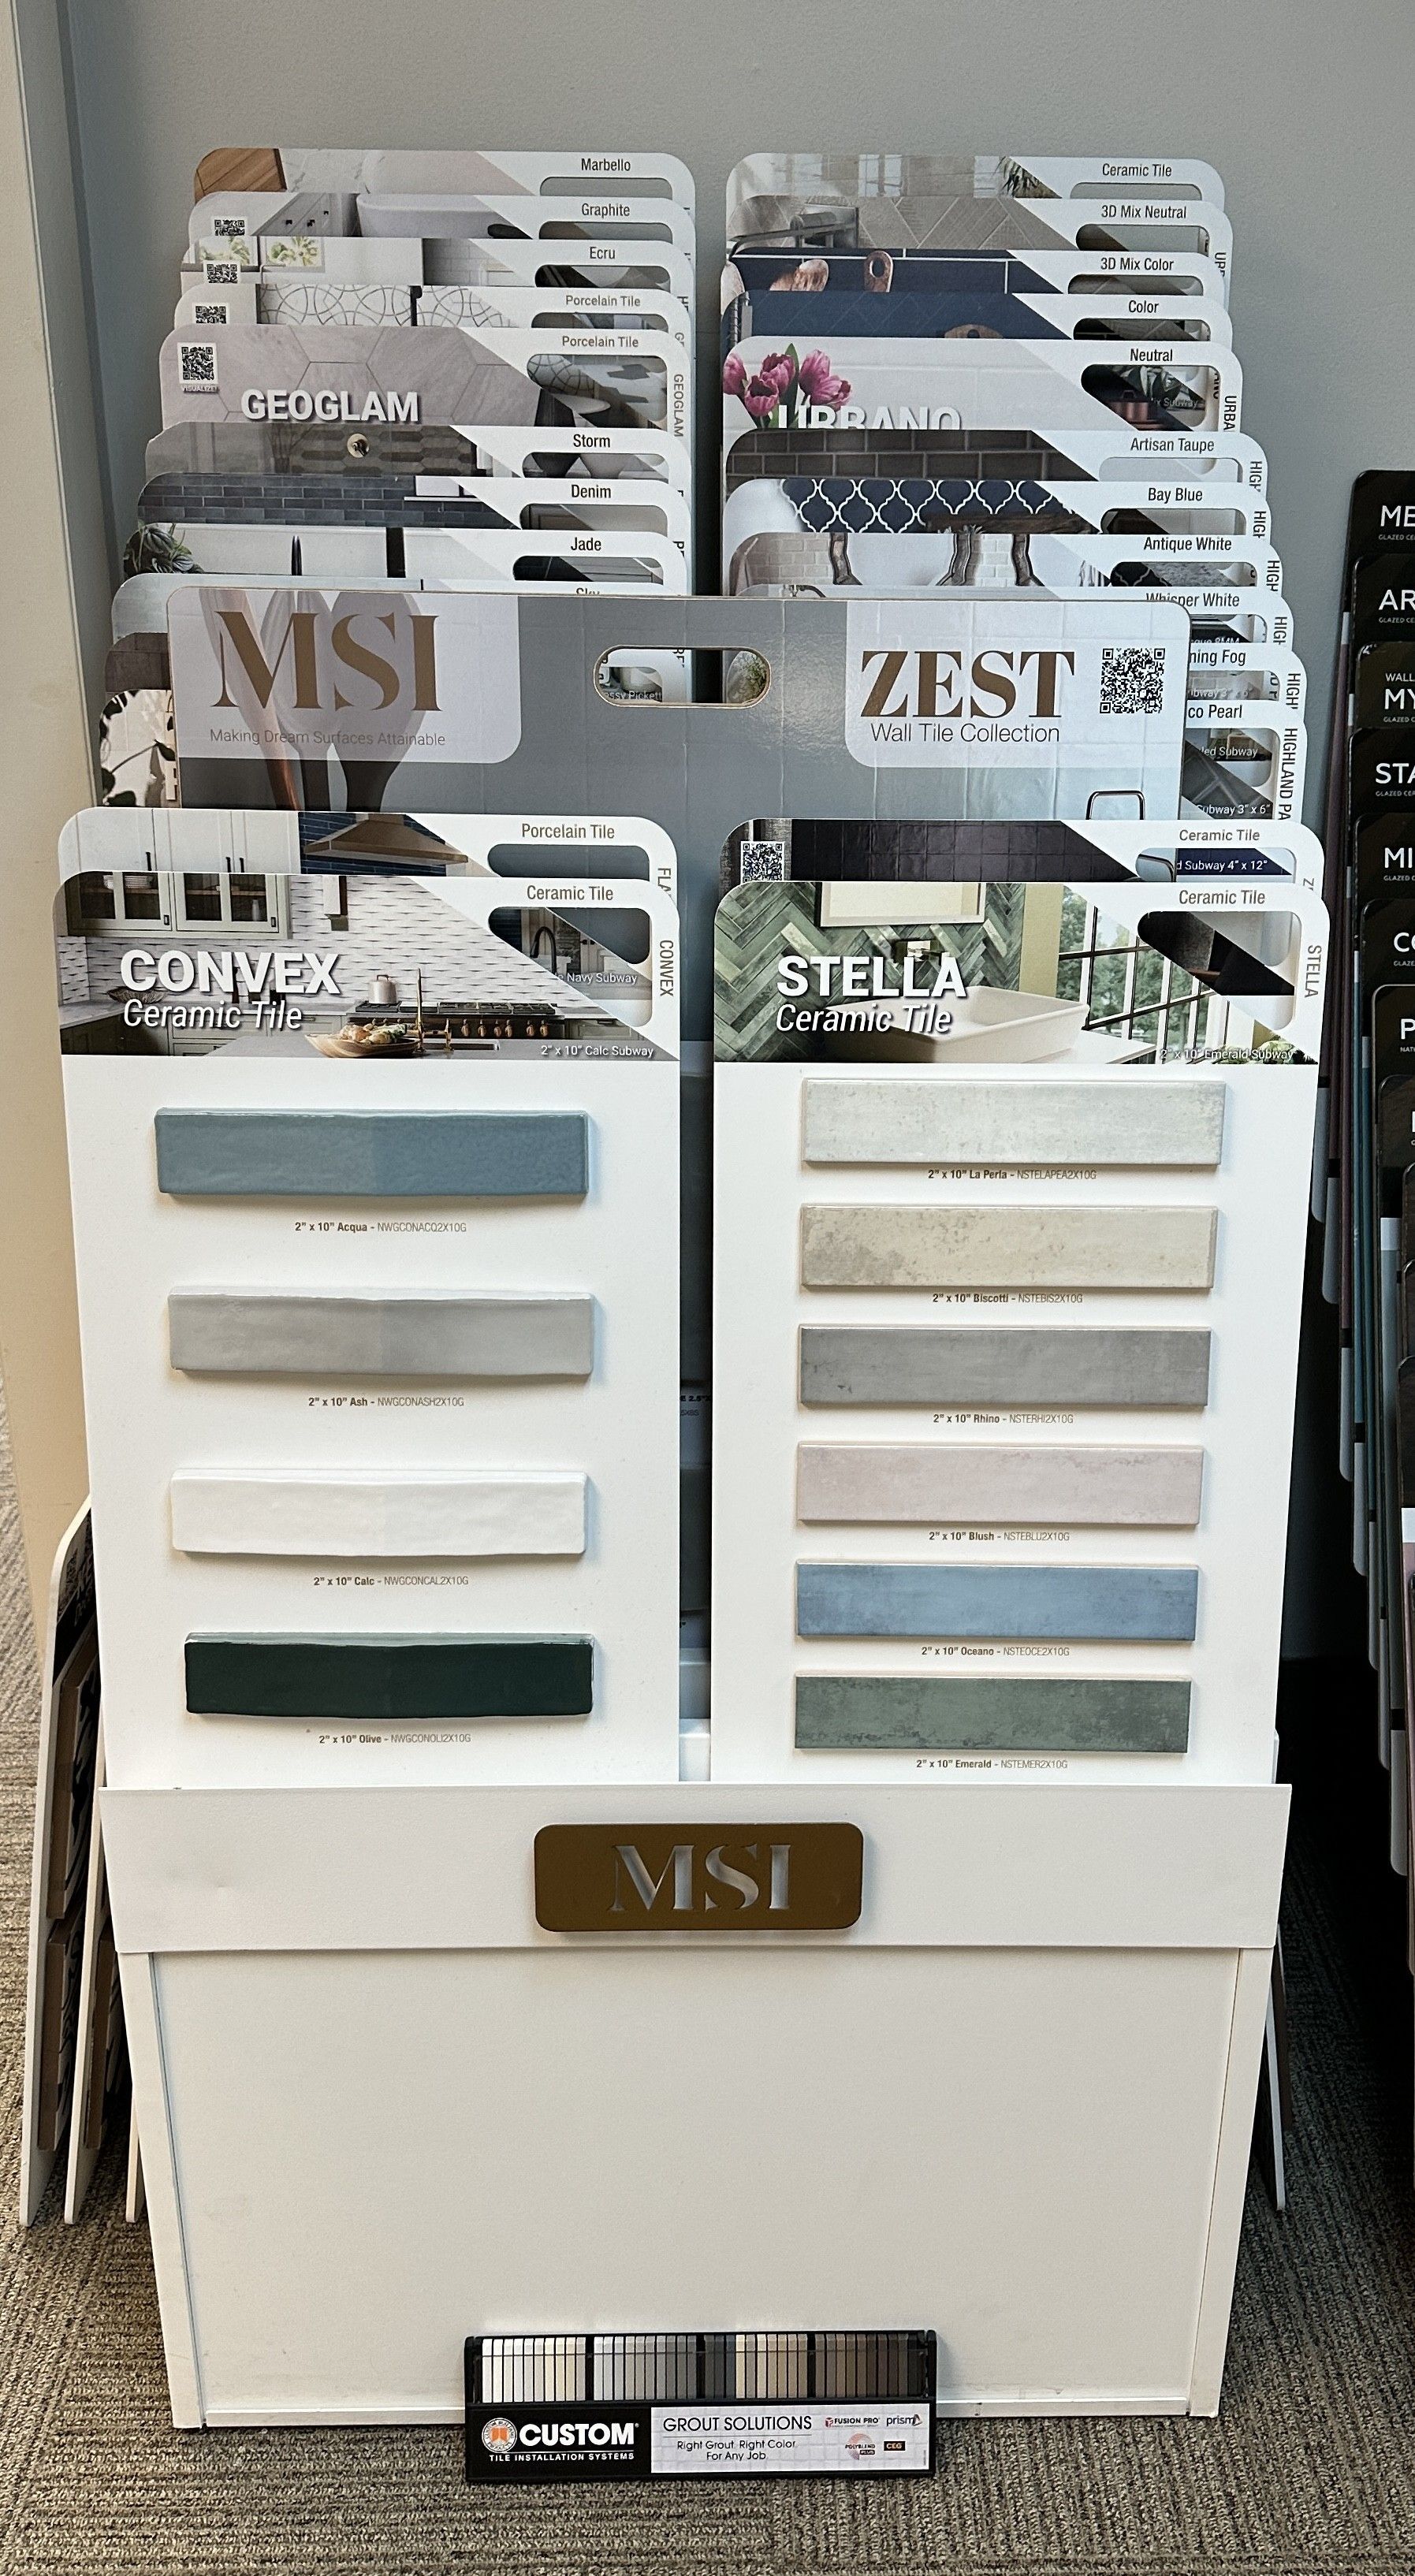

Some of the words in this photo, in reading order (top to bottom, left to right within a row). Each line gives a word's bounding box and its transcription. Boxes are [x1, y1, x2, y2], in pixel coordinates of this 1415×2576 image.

[581, 158, 631, 171] Marbello
[1103, 163, 1149, 177] Ceramic
[1152, 164, 1172, 177] Tile
[582, 203, 630, 218] Graphite
[1101, 205, 1117, 218] 3D
[1121, 206, 1141, 218] Mix
[1145, 206, 1187, 219] Neutral
[590, 247, 616, 259] Ecru
[1101, 258, 1115, 270] 3D
[1120, 258, 1140, 270] Mix
[1144, 258, 1174, 271] Color
[566, 295, 617, 307] Porcelain
[620, 296, 640, 307] Tile
[1128, 300, 1159, 313] Color
[562, 336, 614, 348] Porcelain
[618, 337, 639, 348] Tile
[1130, 348, 1173, 362] Neutral
[241, 389, 419, 422] GEOGLAM
[674, 374, 683, 437] GEOGLAM
[573, 434, 610, 448] Storm
[1130, 437, 1174, 452] Artisan
[1178, 438, 1214, 454] Taupe
[572, 484, 611, 498] Denim
[1148, 487, 1171, 504] Bay
[1175, 488, 1203, 501] Blue
[571, 537, 601, 551] Jade
[1144, 538, 1193, 553] Antique
[1196, 538, 1231, 551] White
[1203, 593, 1240, 607] White
[210, 610, 443, 712] MSI
[1222, 650, 1246, 666] Fog
[861, 650, 1075, 719] ZEST
[1208, 705, 1243, 719] Pearl
[210, 728, 260, 746] Making
[265, 730, 310, 744] Dream
[314, 731, 374, 745] Surfaces
[378, 731, 446, 746] Attainable
[870, 723, 912, 742] Wall
[921, 723, 953, 742] Tile
[961, 723, 1059, 743] Collection
[1219, 747, 1258, 759] Subway
[1279, 728, 1298, 799] HIGHLAND
[522, 824, 586, 838] Porcelain
[590, 825, 615, 839] Tile
[1179, 829, 1233, 842] Ceramic
[1236, 829, 1260, 842] Tile
[1185, 861, 1225, 873] Subway
[527, 885, 585, 900] Ceramic
[588, 886, 613, 900] Tile
[1179, 890, 1236, 904] Ceramic
[1241, 889, 1265, 904] Tile
[121, 949, 341, 994] CONVEX
[660, 940, 674, 997] CONVEX
[776, 953, 966, 998] STELLA
[1305, 945, 1321, 998] STELLA
[567, 973, 593, 985] Navy
[596, 973, 638, 985] Subway
[124, 999, 241, 1029] Ceramic
[251, 1000, 303, 1029] Tile
[776, 1003, 892, 1032] Ceramic
[903, 1003, 952, 1033] Tile
[585, 1045, 609, 1056] Calc
[612, 1045, 654, 1058] Subway
[1205, 1049, 1249, 1059] Emerald
[1252, 1049, 1293, 1062] Subway
[970, 1170, 981, 1179] La
[984, 1170, 1007, 1179] Perla
[337, 1223, 367, 1233] Acqua
[974, 1294, 1008, 1302] Biscotti
[350, 1398, 367, 1406] Ash
[974, 1414, 1000, 1423] Rhino
[355, 1576, 374, 1585] Calc
[359, 1735, 382, 1744] Olive
[955, 1759, 992, 1768] Emerald
[608, 1844, 791, 1912] MSI
[663, 2417, 720, 2432] GROUT
[724, 2416, 812, 2430] SOLUTIONS
[677, 2440, 702, 2451] Right
[739, 2440, 765, 2451] Right
[706, 2451, 722, 2461] For
[724, 2451, 744, 2461] Any
